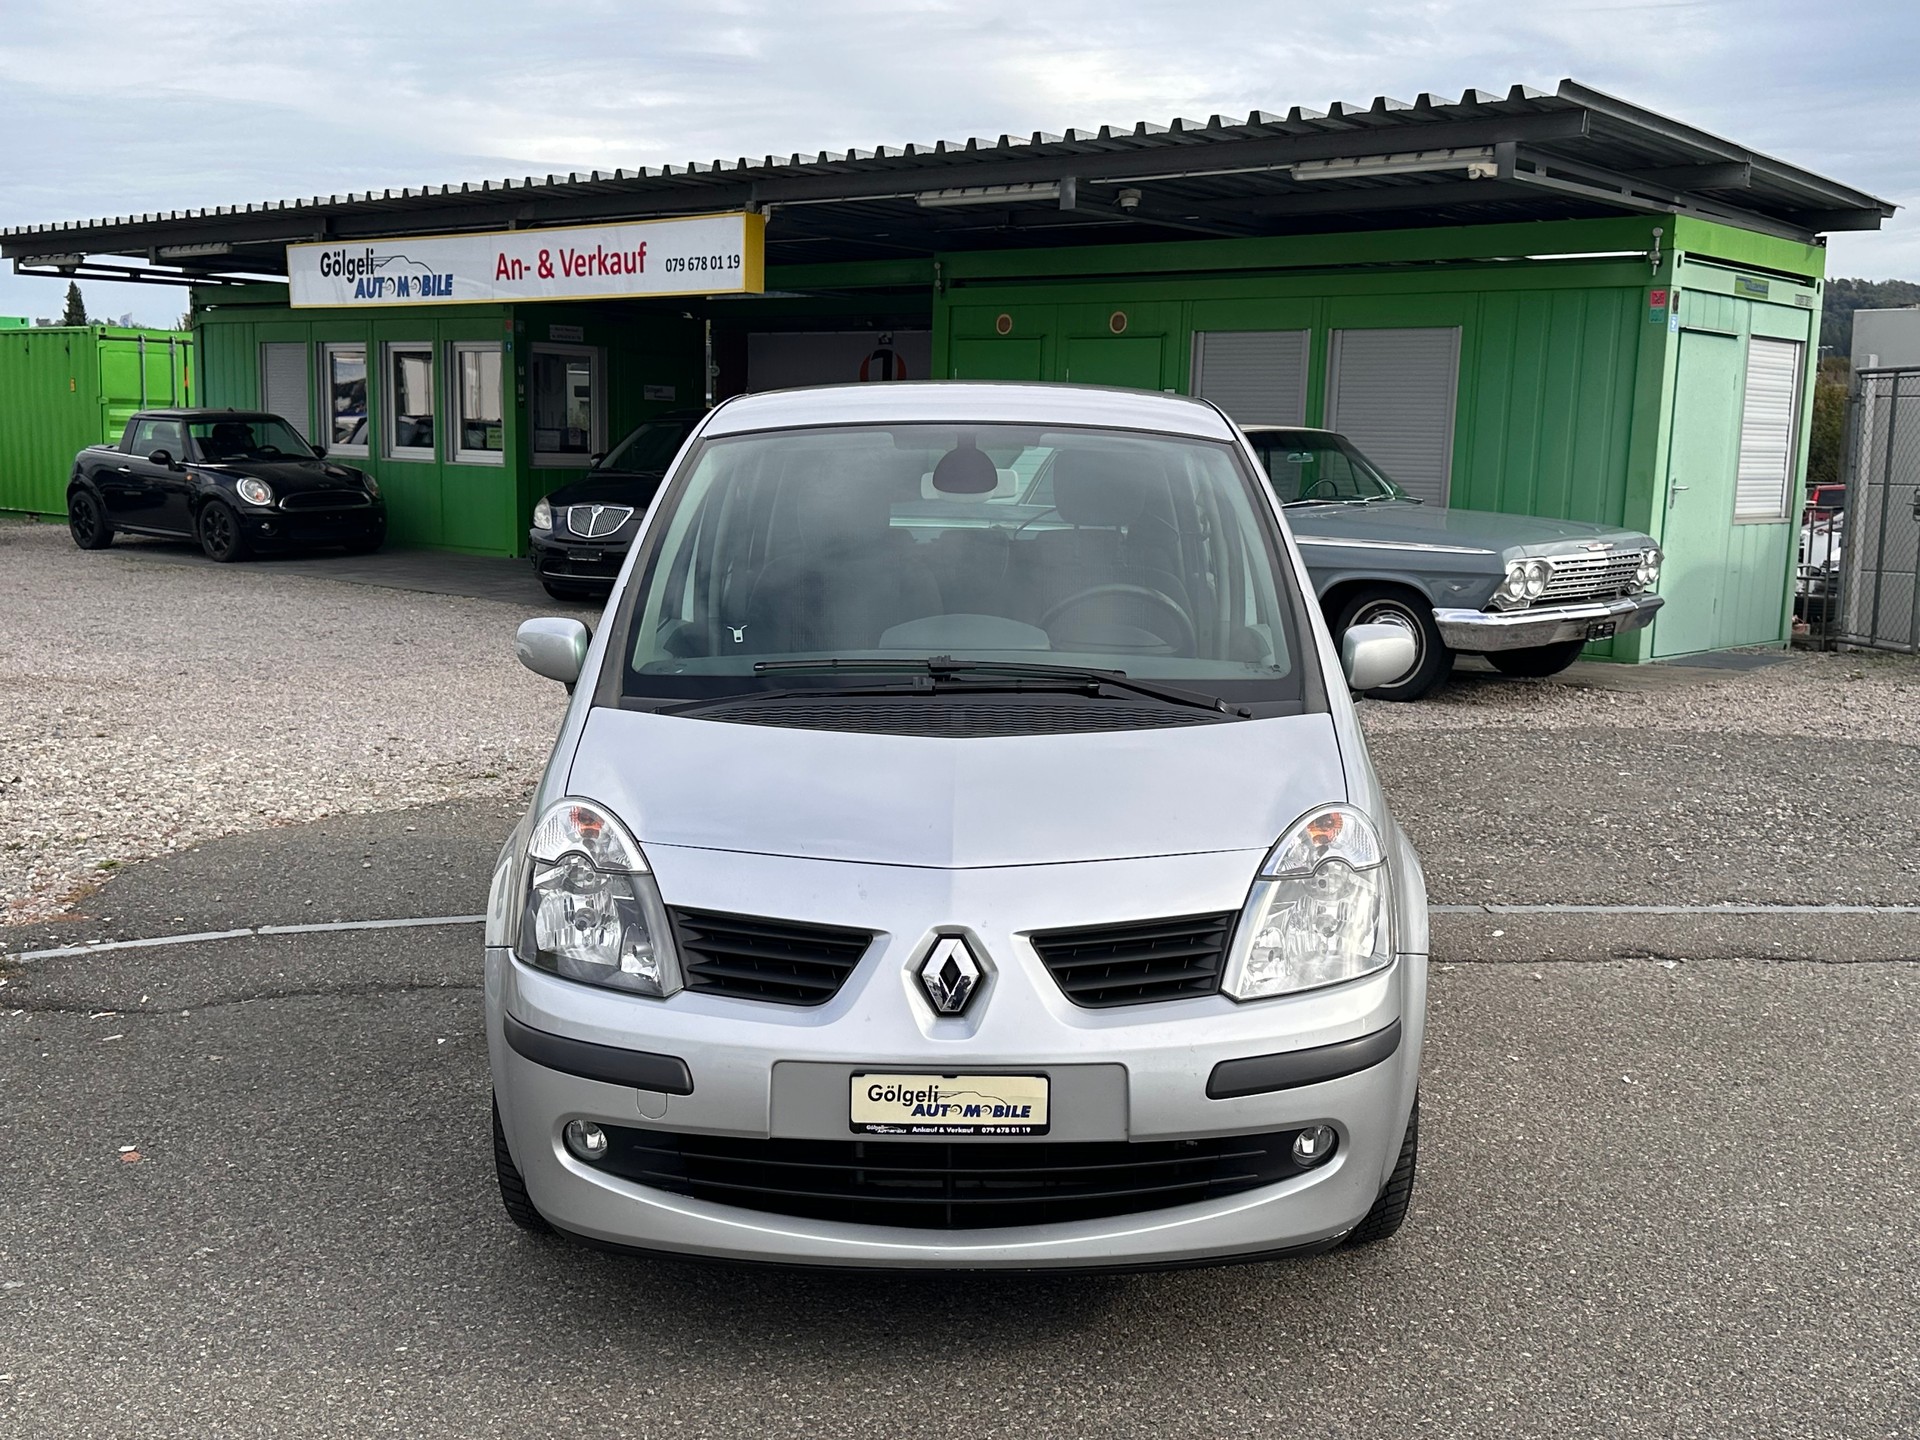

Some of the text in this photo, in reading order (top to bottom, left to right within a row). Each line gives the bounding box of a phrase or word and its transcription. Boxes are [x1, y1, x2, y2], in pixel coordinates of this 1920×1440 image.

[320, 248, 374, 283] Gölgeli
[495, 241, 647, 281] An- & Verkauf
[665, 254, 741, 273] 079 678 01 19
[867, 1084, 939, 1107] Gölgeli
[946, 1126, 974, 1134] Verkauf
